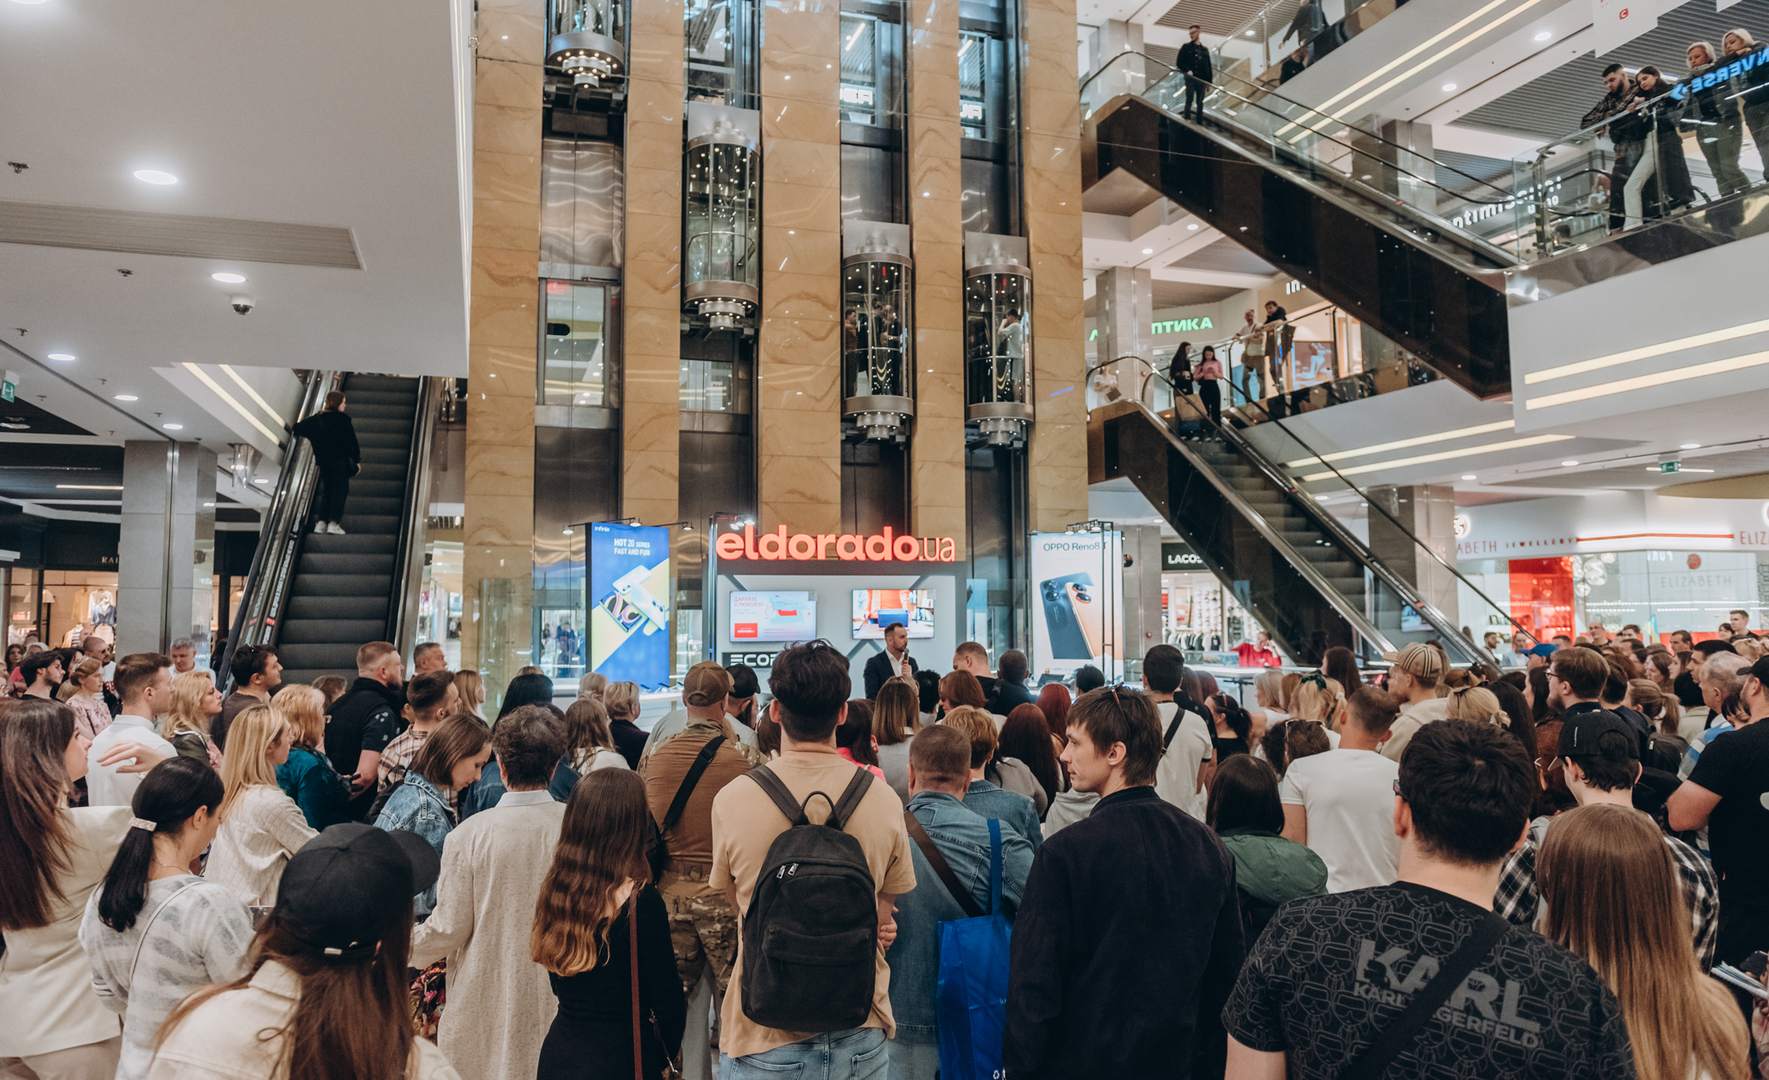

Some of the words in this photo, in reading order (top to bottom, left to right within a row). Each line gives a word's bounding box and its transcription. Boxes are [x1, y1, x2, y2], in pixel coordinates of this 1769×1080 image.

[1151, 316, 1214, 335] ПТИКА
[614, 538, 627, 547] HOT
[627, 539, 635, 547] 20
[715, 524, 956, 562] eldorado.ua
[1043, 542, 1070, 552] OPPO
[1071, 541, 1100, 551] Reno8
[1660, 575, 1733, 588] ELIZABETH
[1356, 938, 1541, 1034] KARL
[1432, 1004, 1540, 1049] GERFELD
